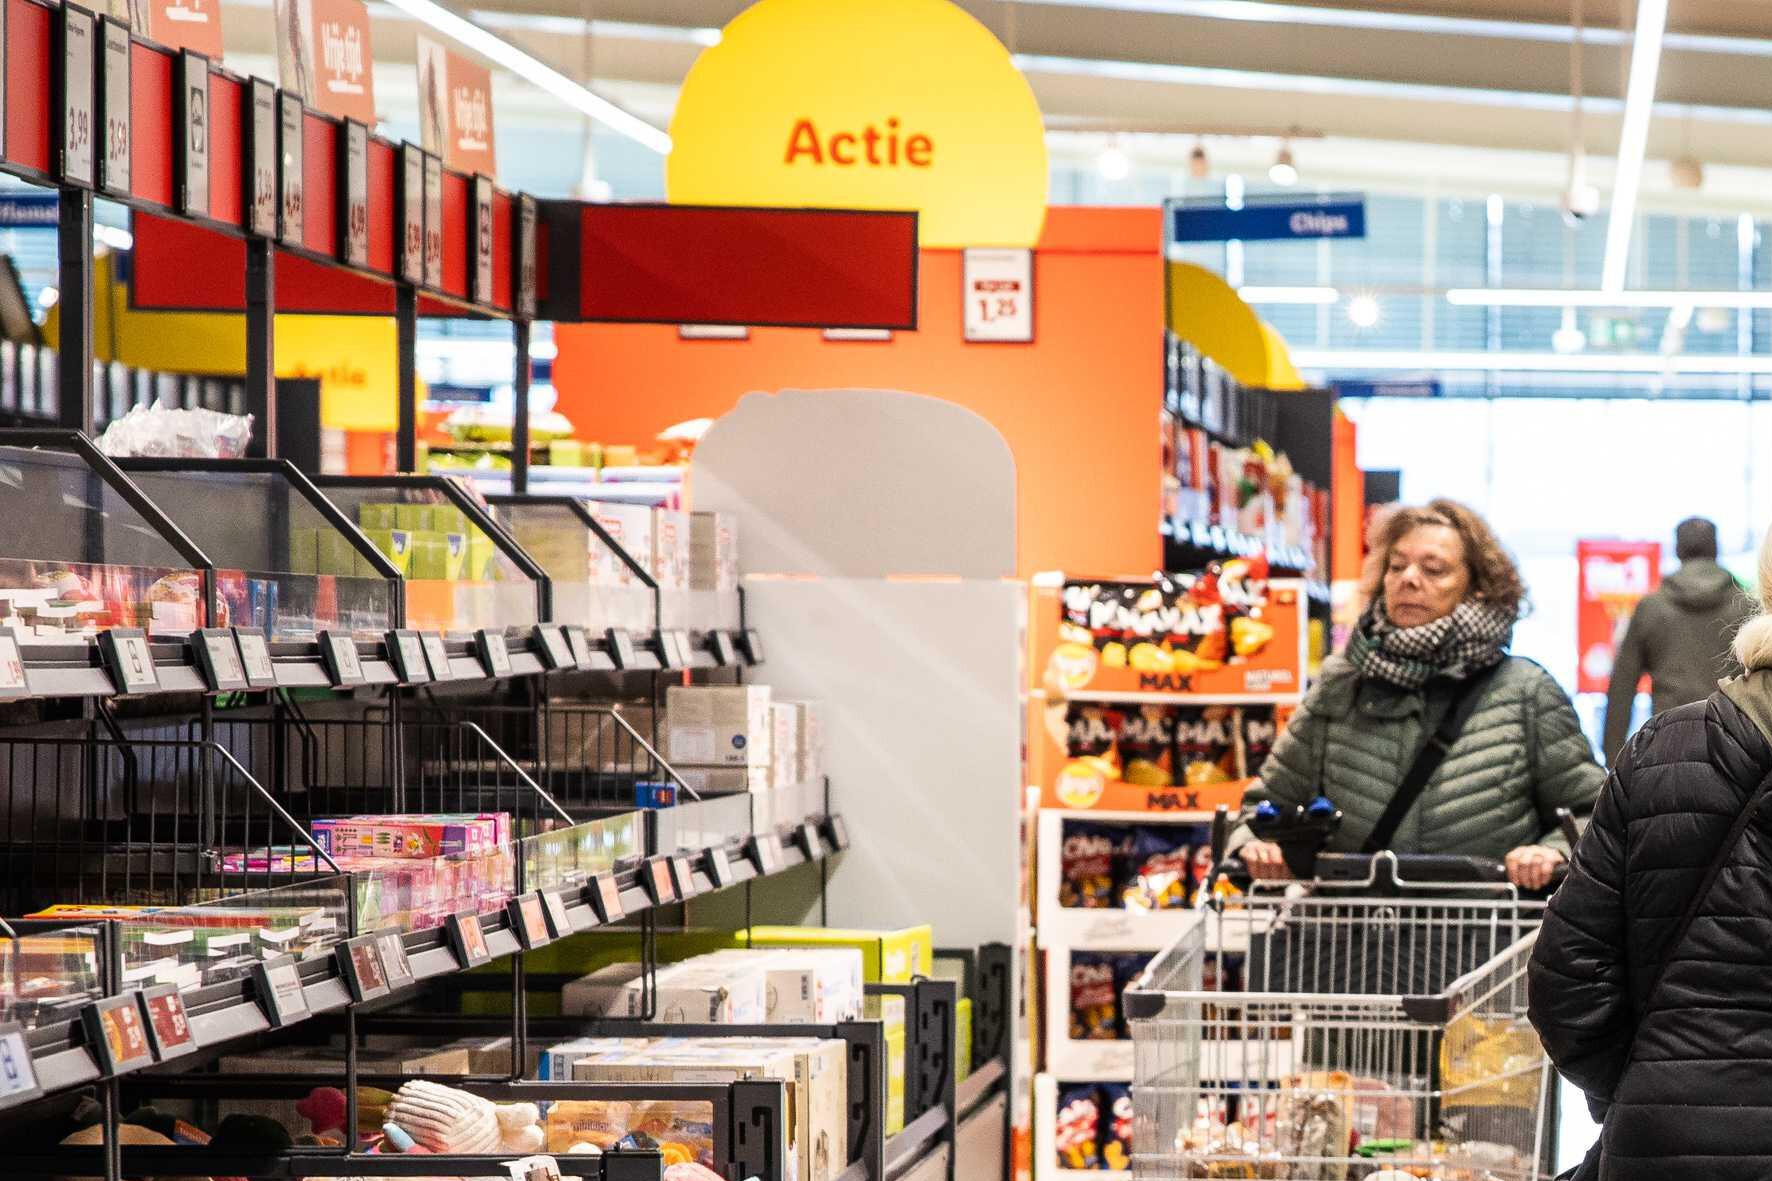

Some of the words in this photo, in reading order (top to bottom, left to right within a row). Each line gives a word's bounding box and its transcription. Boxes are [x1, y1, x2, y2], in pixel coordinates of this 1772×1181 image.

[68, 106, 89, 151] 3,99
[783, 118, 934, 168] Actie
[1290, 211, 1349, 235] Chips
[1139, 672, 1193, 692] MAX
[1147, 792, 1199, 809] MAX
